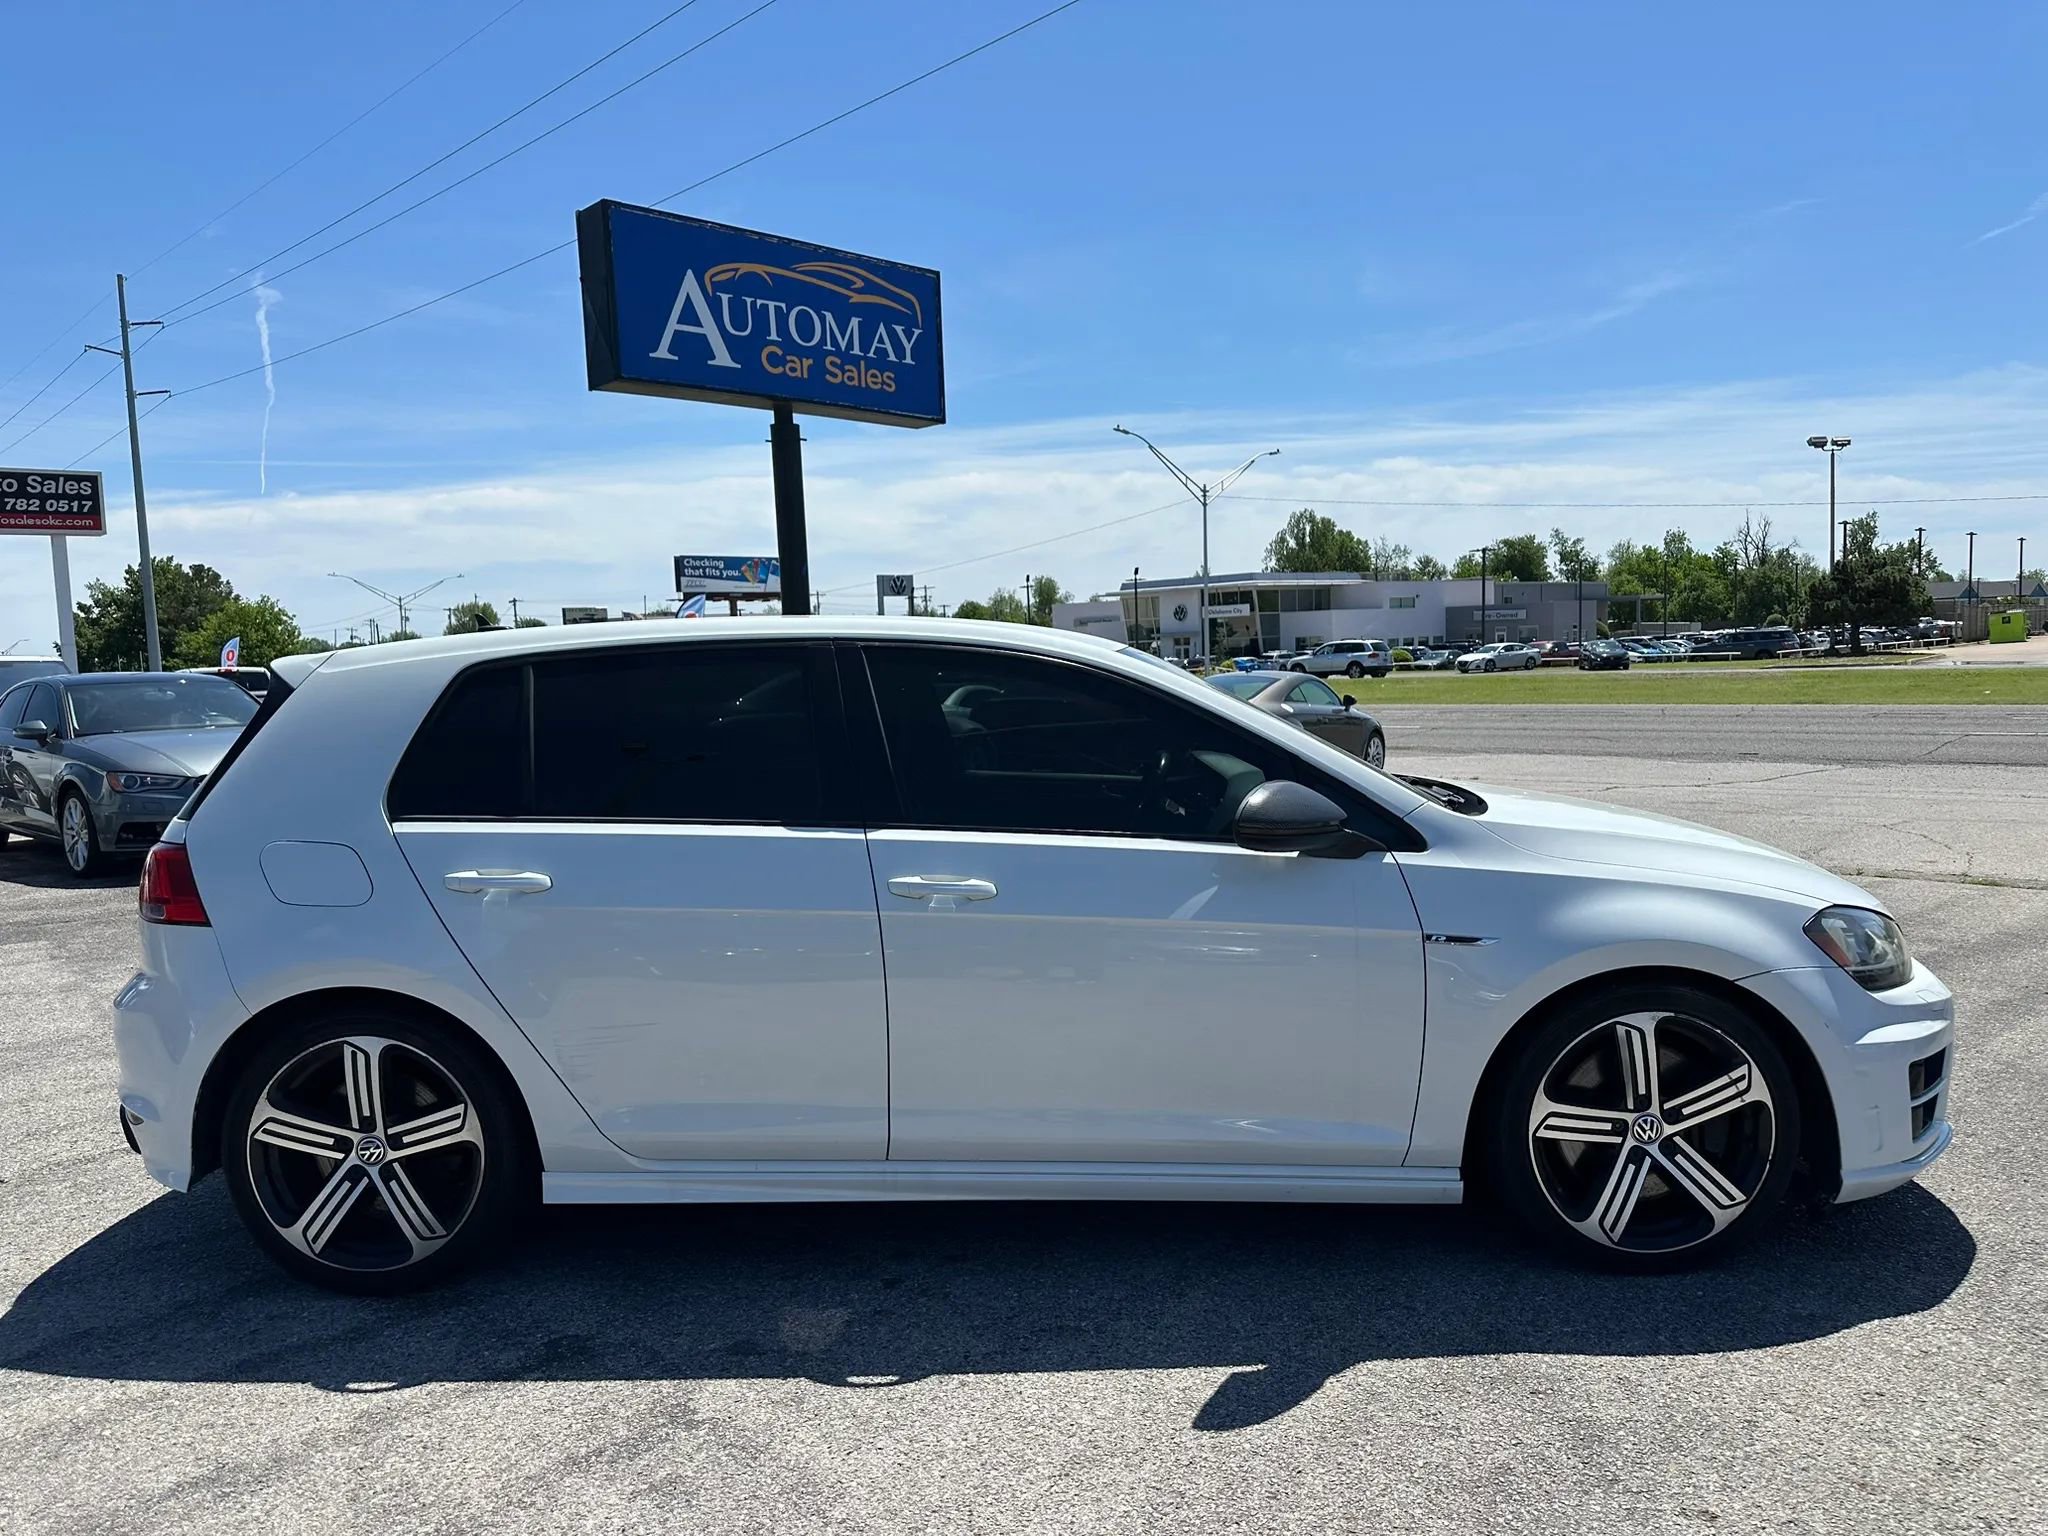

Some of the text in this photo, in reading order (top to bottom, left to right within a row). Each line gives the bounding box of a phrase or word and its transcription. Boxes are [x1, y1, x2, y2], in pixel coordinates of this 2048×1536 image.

[761, 345, 896, 393] Car Sales
[0, 475, 93, 495] o Sales
[4, 498, 93, 513] 782 0517
[0, 514, 94, 526] osalesokc.com
[683, 558, 724, 568] Checking
[684, 567, 742, 578] that fits you.
